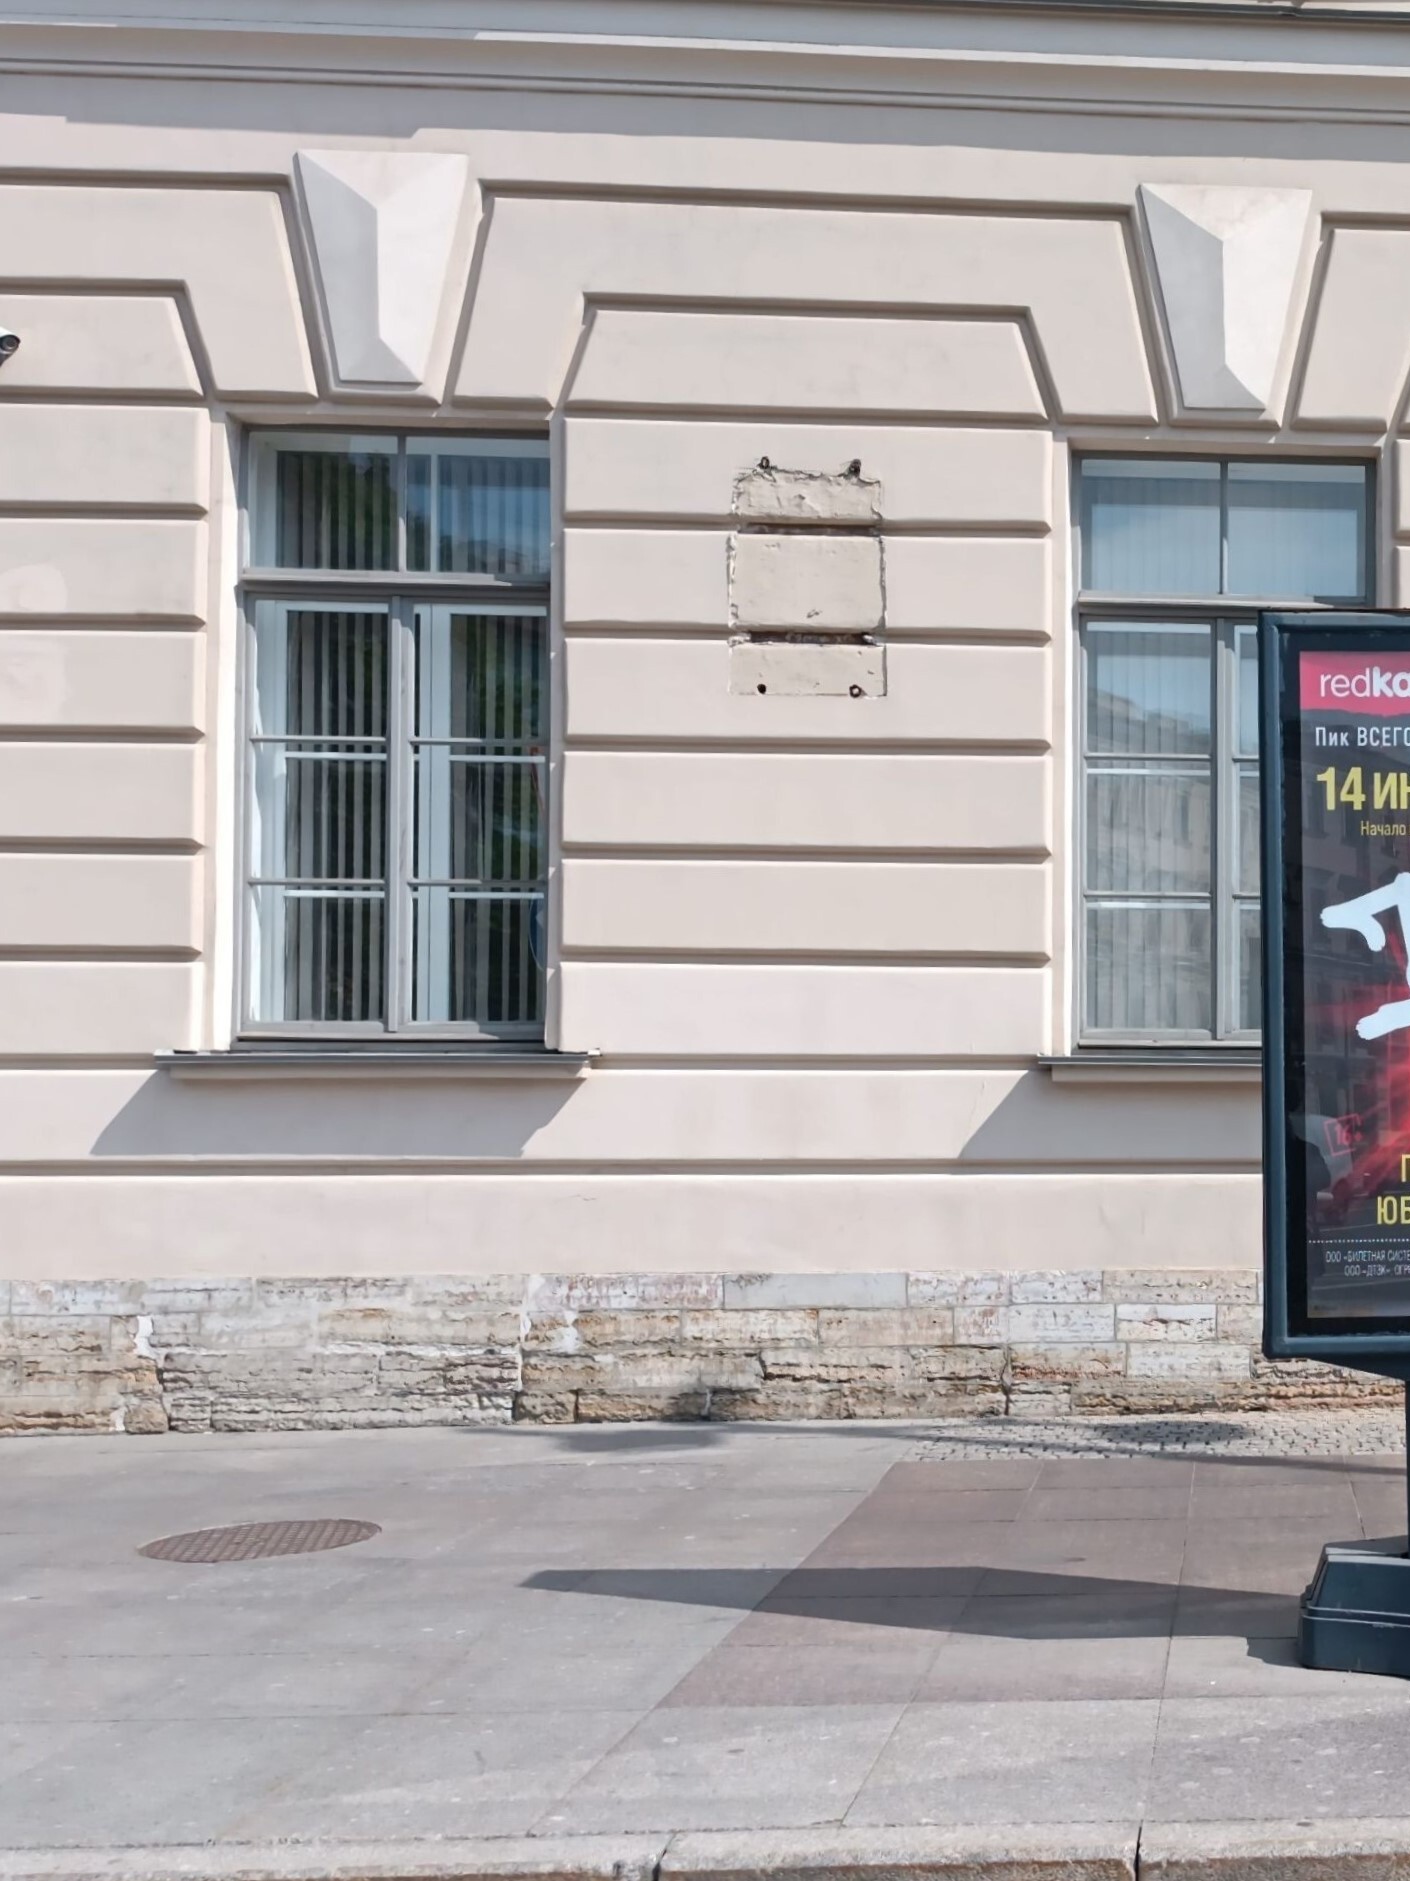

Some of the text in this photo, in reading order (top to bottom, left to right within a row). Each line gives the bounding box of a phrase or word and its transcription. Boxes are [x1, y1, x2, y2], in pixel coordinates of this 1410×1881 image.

[1315, 727, 1349, 747] Пик
[1316, 766, 1366, 811] 14
[1360, 820, 1406, 836] Начало
[1326, 1251, 1341, 1262] ООО
[1344, 1265, 1360, 1276] ООО
